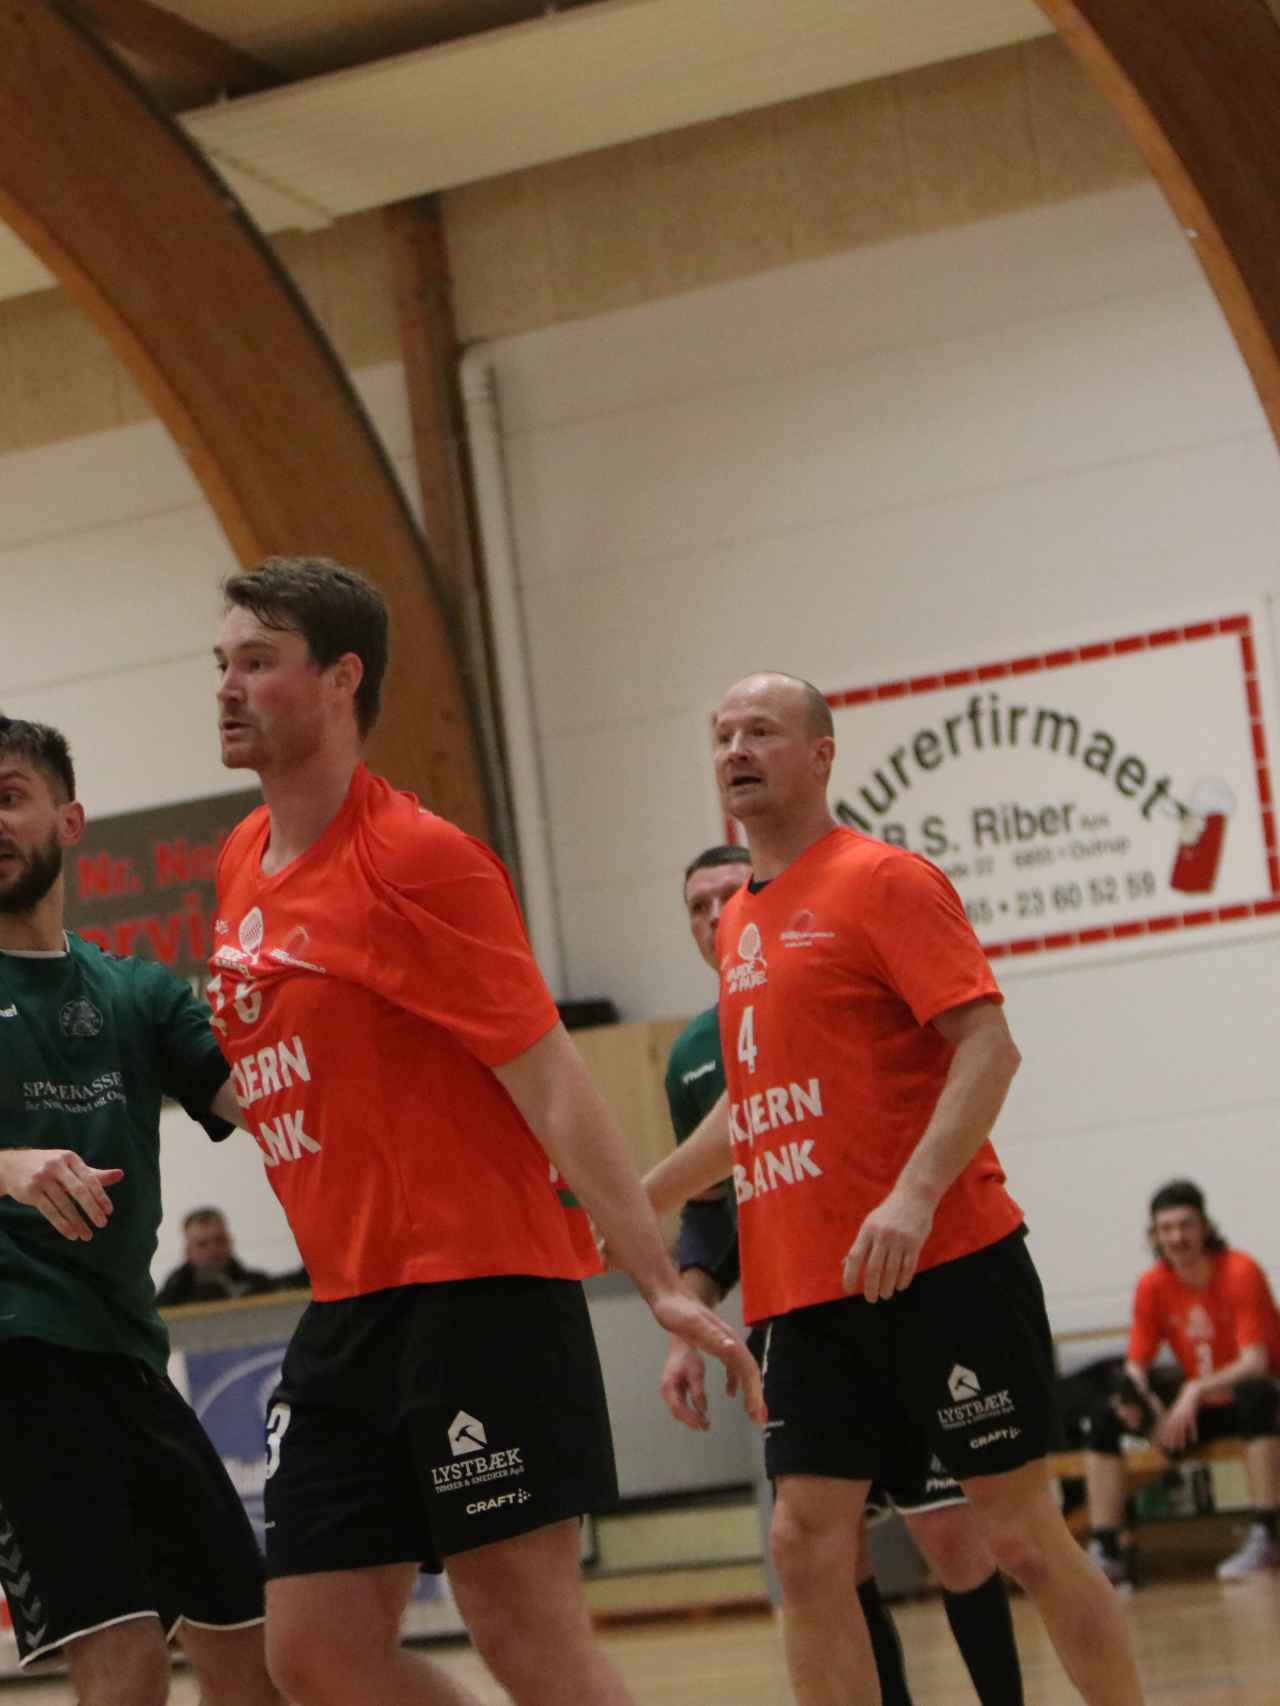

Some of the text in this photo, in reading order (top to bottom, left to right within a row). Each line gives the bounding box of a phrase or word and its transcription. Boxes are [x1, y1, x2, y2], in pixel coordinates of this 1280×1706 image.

[972, 802, 1074, 847] Riber
[155, 838, 220, 887] Ne
[737, 1004, 758, 1074] 4
[732, 1139, 823, 1204] BANK
[431, 1447, 524, 1485] LYSTBÆK
[466, 1492, 517, 1515] CRAFT
